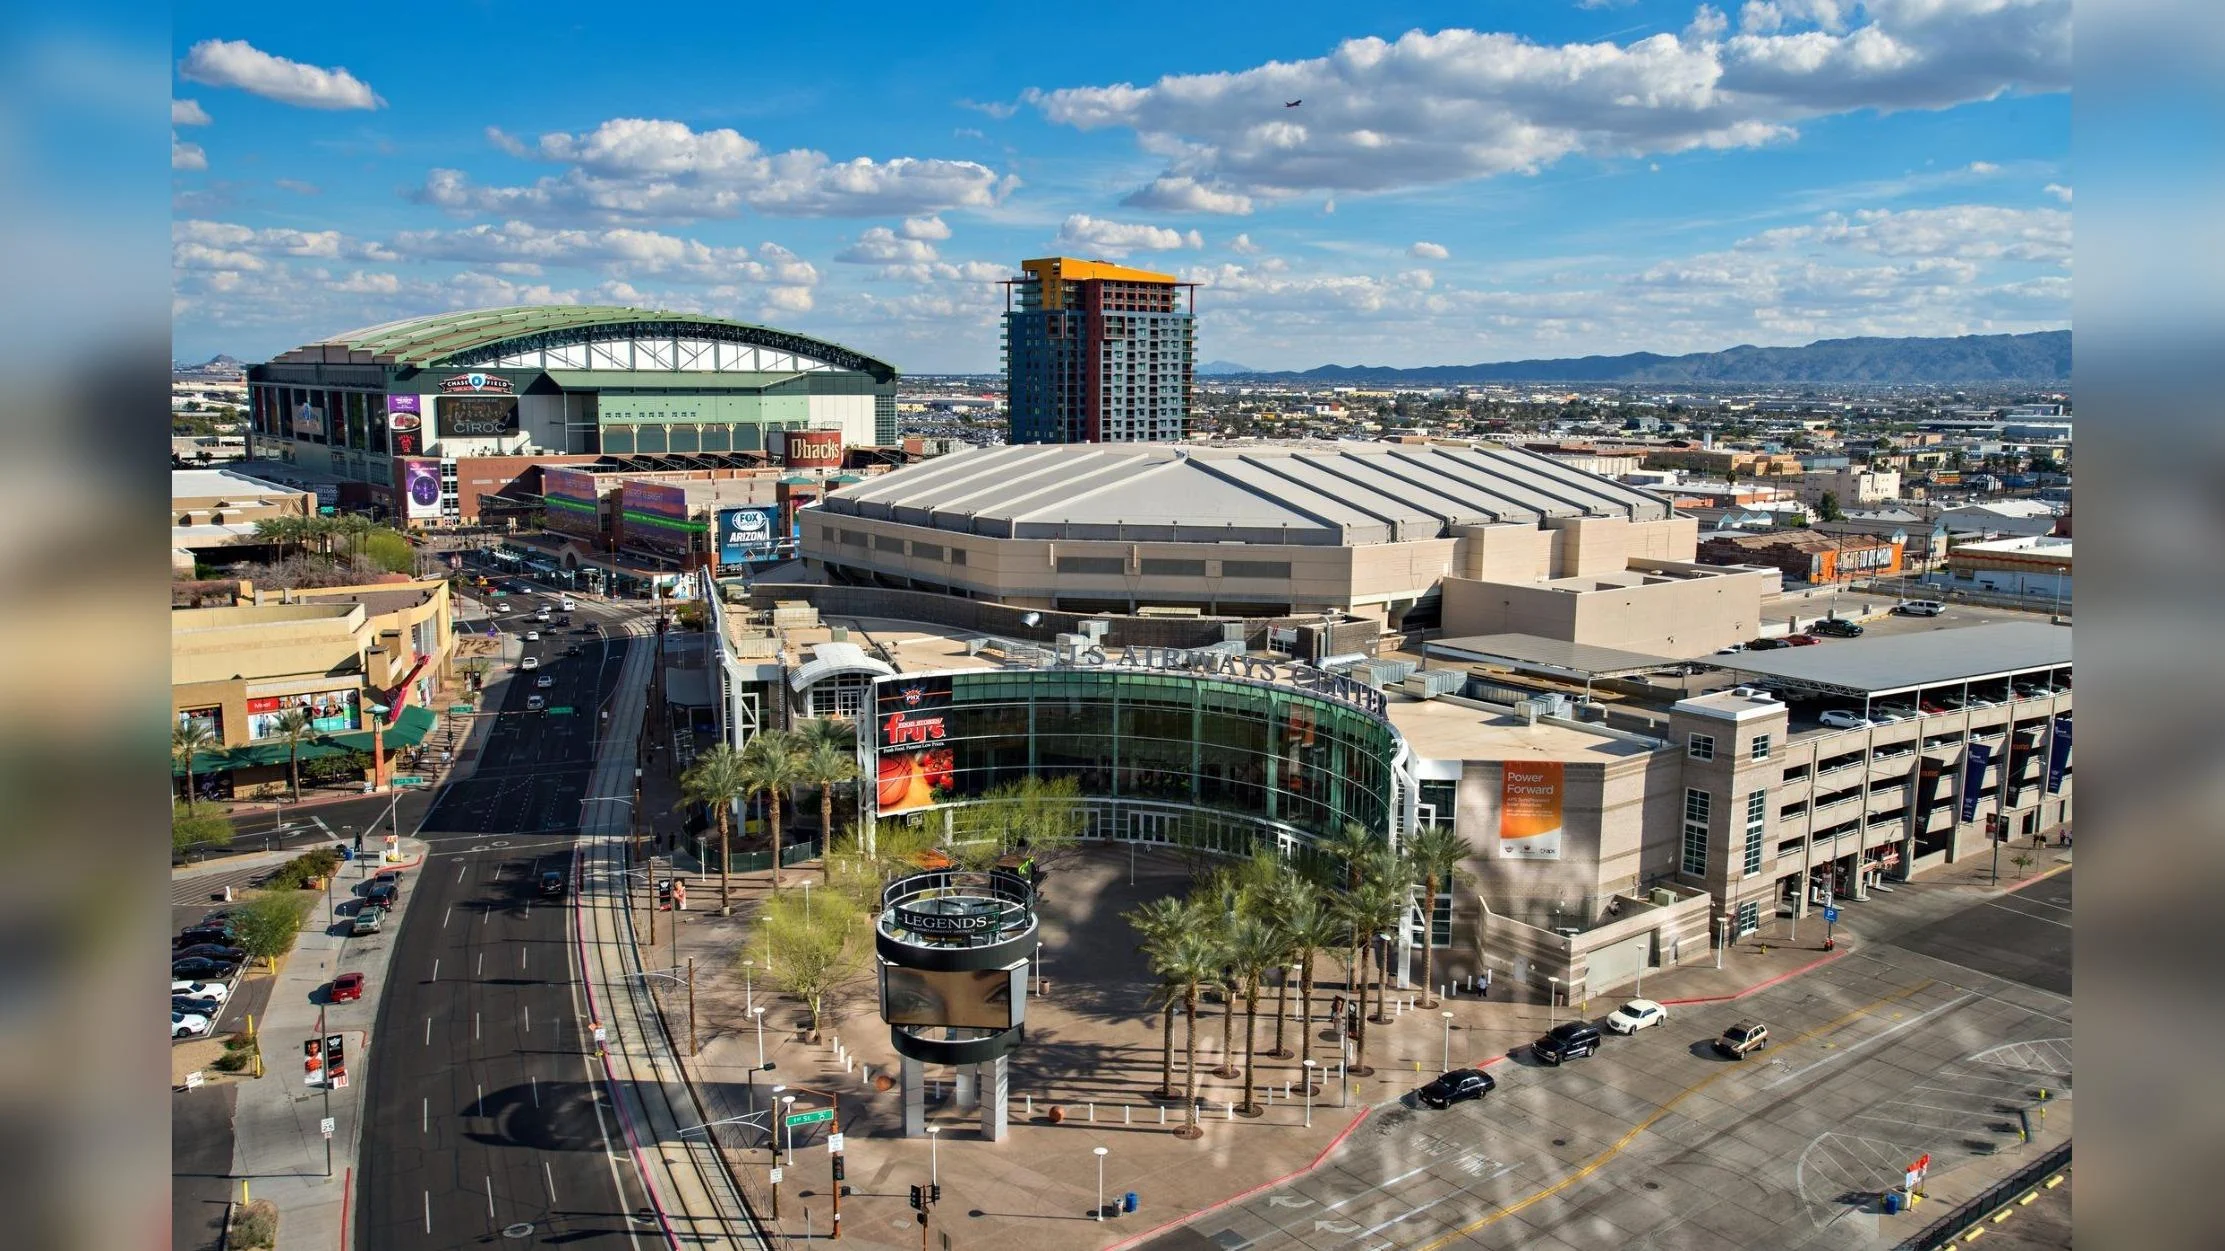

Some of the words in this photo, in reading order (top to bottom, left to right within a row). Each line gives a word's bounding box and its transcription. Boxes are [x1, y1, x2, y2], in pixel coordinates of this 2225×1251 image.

[740, 512, 758, 522] FOX
[1116, 645, 1276, 682] AIRWAYS
[1291, 665, 1389, 720] CENTER
[906, 694, 920, 702] PHX
[1507, 771, 1544, 782] Power
[1507, 784, 1554, 795] Forward
[904, 913, 987, 929] LEGENDS
[322, 1124, 334, 1132] 25
